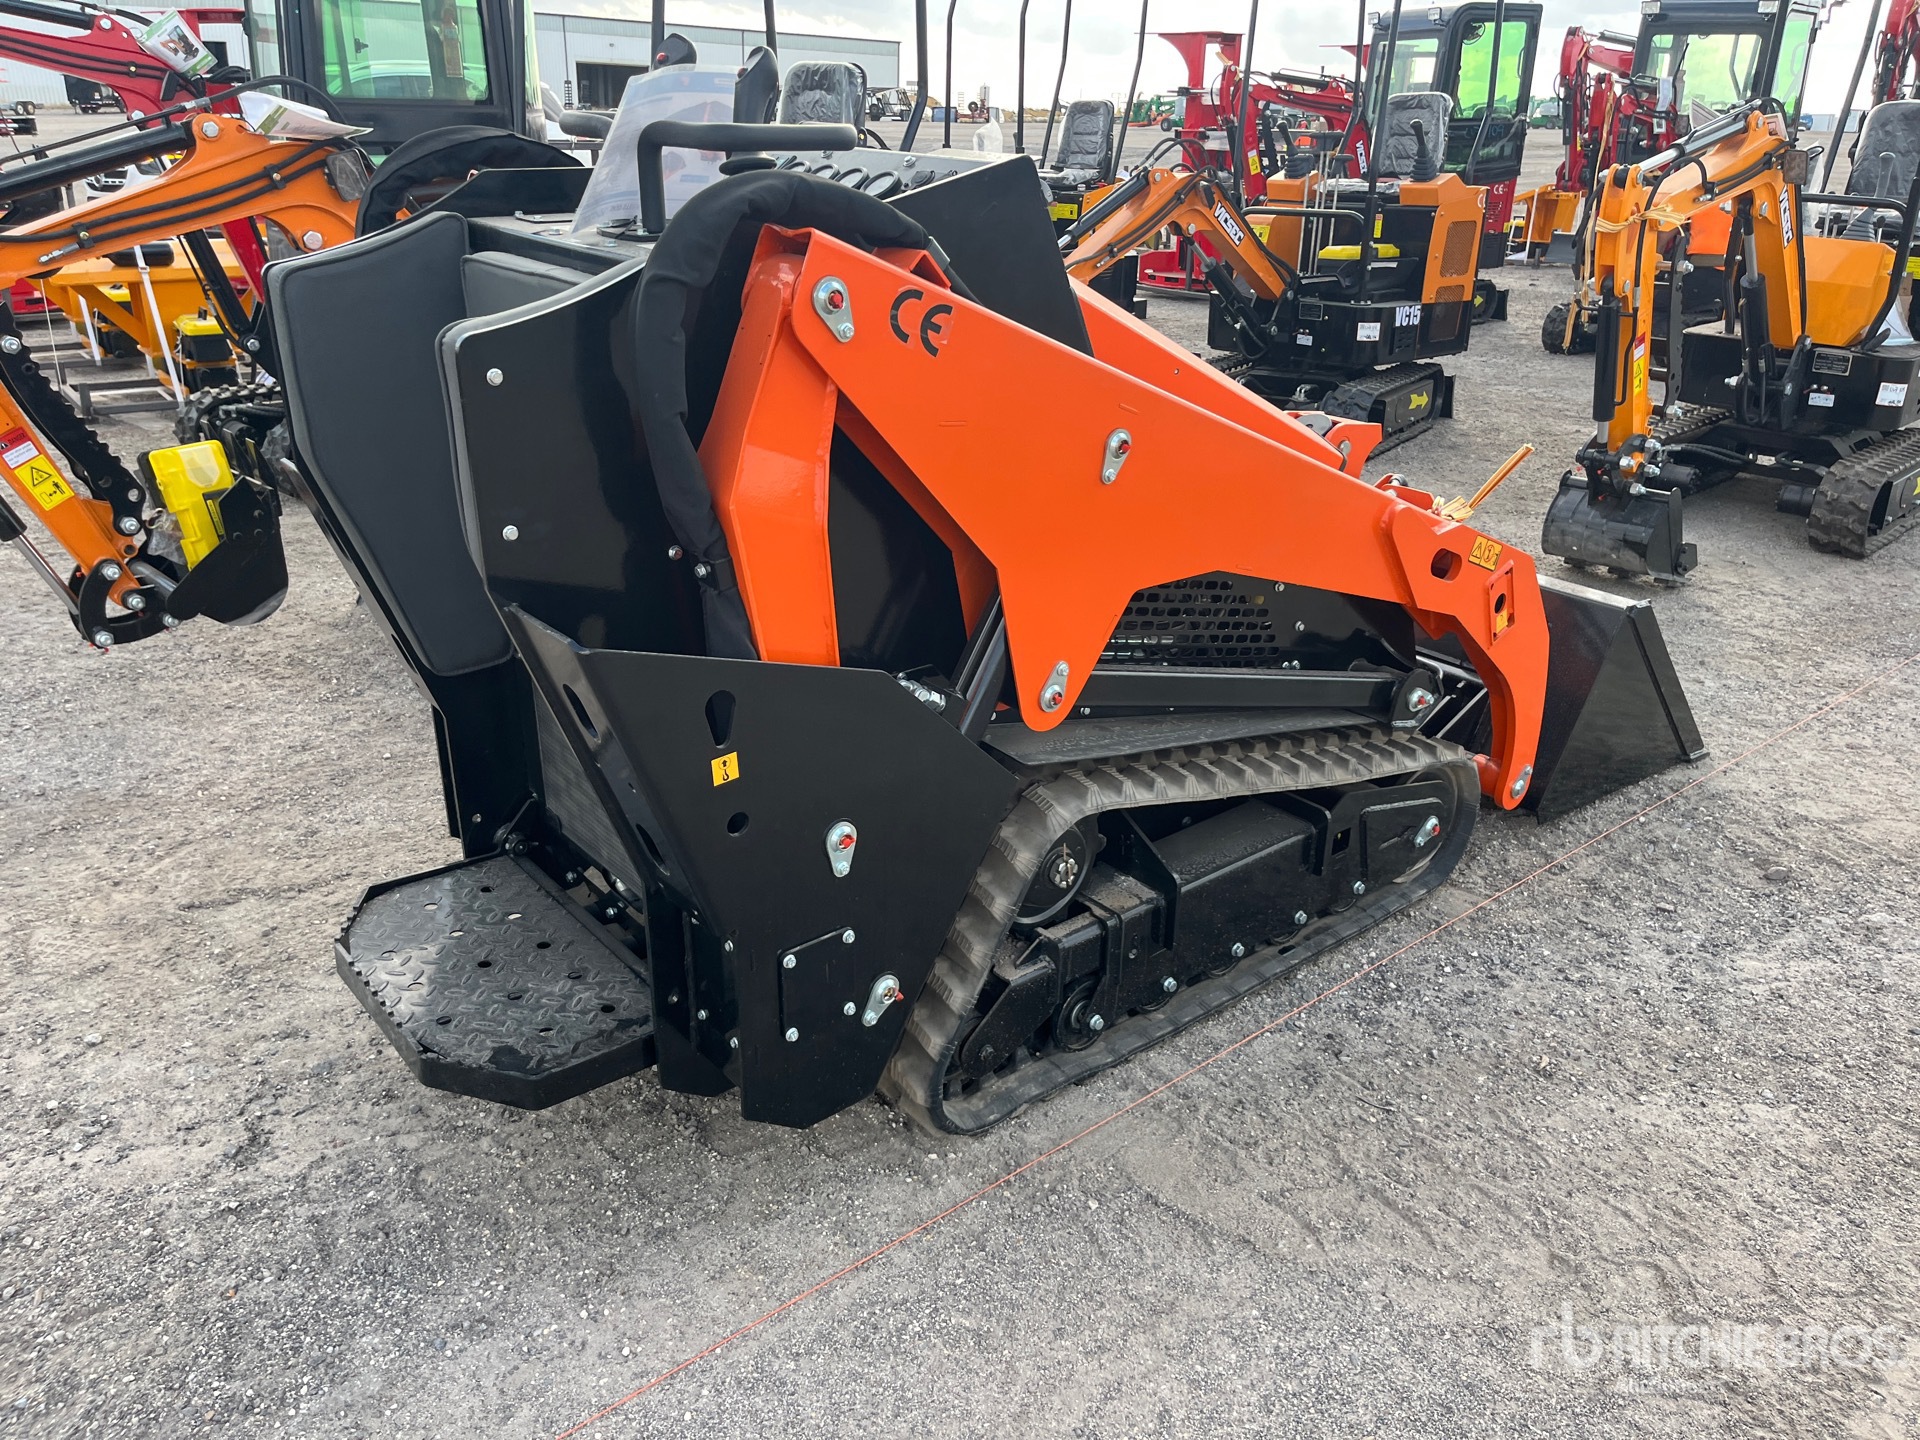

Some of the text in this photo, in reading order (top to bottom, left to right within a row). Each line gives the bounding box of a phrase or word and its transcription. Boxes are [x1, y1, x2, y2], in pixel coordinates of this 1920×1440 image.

[1214, 200, 1245, 246] VICSEC
[1778, 183, 1794, 248] VICSEC
[889, 288, 953, 358] CE
[1395, 305, 1421, 327] VC15
